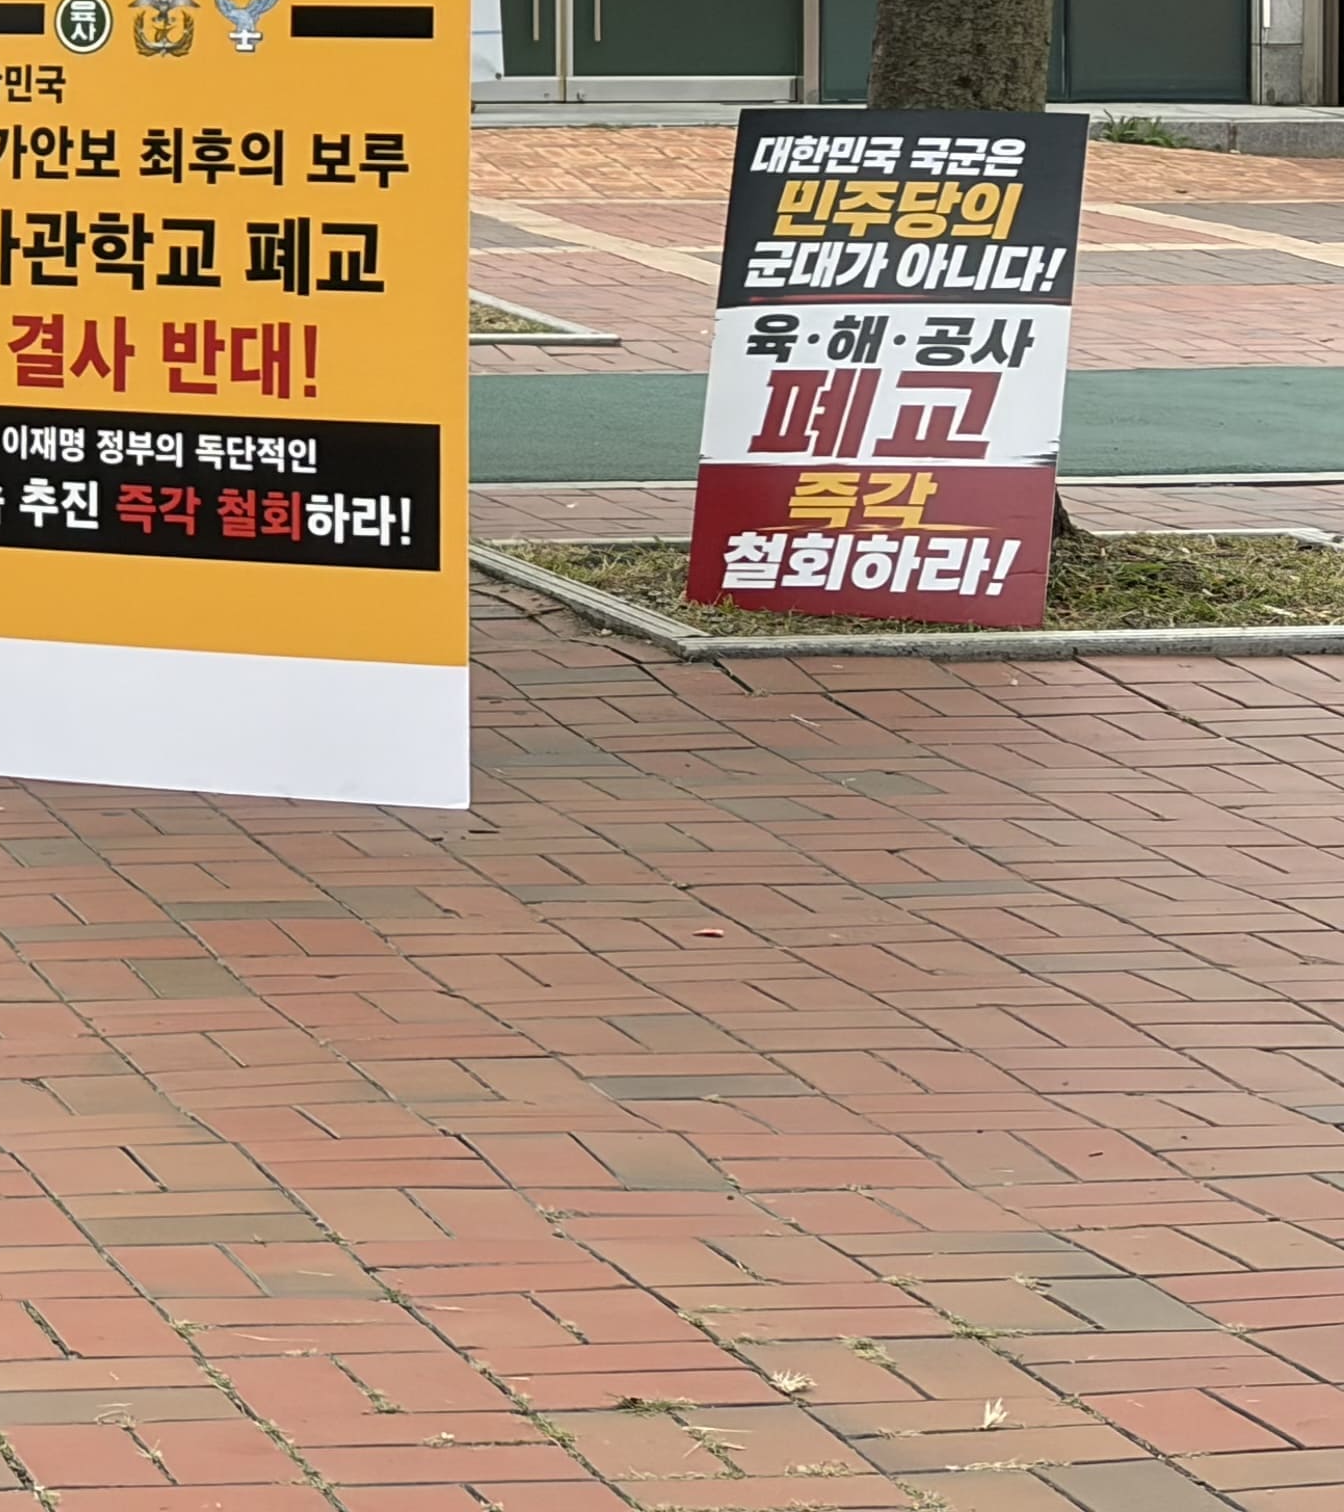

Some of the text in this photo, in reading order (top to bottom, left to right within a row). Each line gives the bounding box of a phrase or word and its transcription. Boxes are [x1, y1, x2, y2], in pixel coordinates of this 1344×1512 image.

[139, 127, 286, 186] 최후의
[306, 132, 410, 188] 보루
[750, 135, 1028, 178] 대한민국 국군은
[772, 180, 1024, 241] 민주당의
[245, 216, 385, 297] 폐교
[743, 240, 1068, 292] 군대가 아니다!
[8, 313, 318, 400] 결사 반대!
[1, 424, 318, 475] 이재명 정부의 독단적인
[18, 478, 100, 530] 추진
[115, 482, 202, 537] 즉각
[216, 486, 413, 546] 철회하라!
[787, 471, 939, 529] 즉각
[721, 532, 1022, 597] 철회하라!
